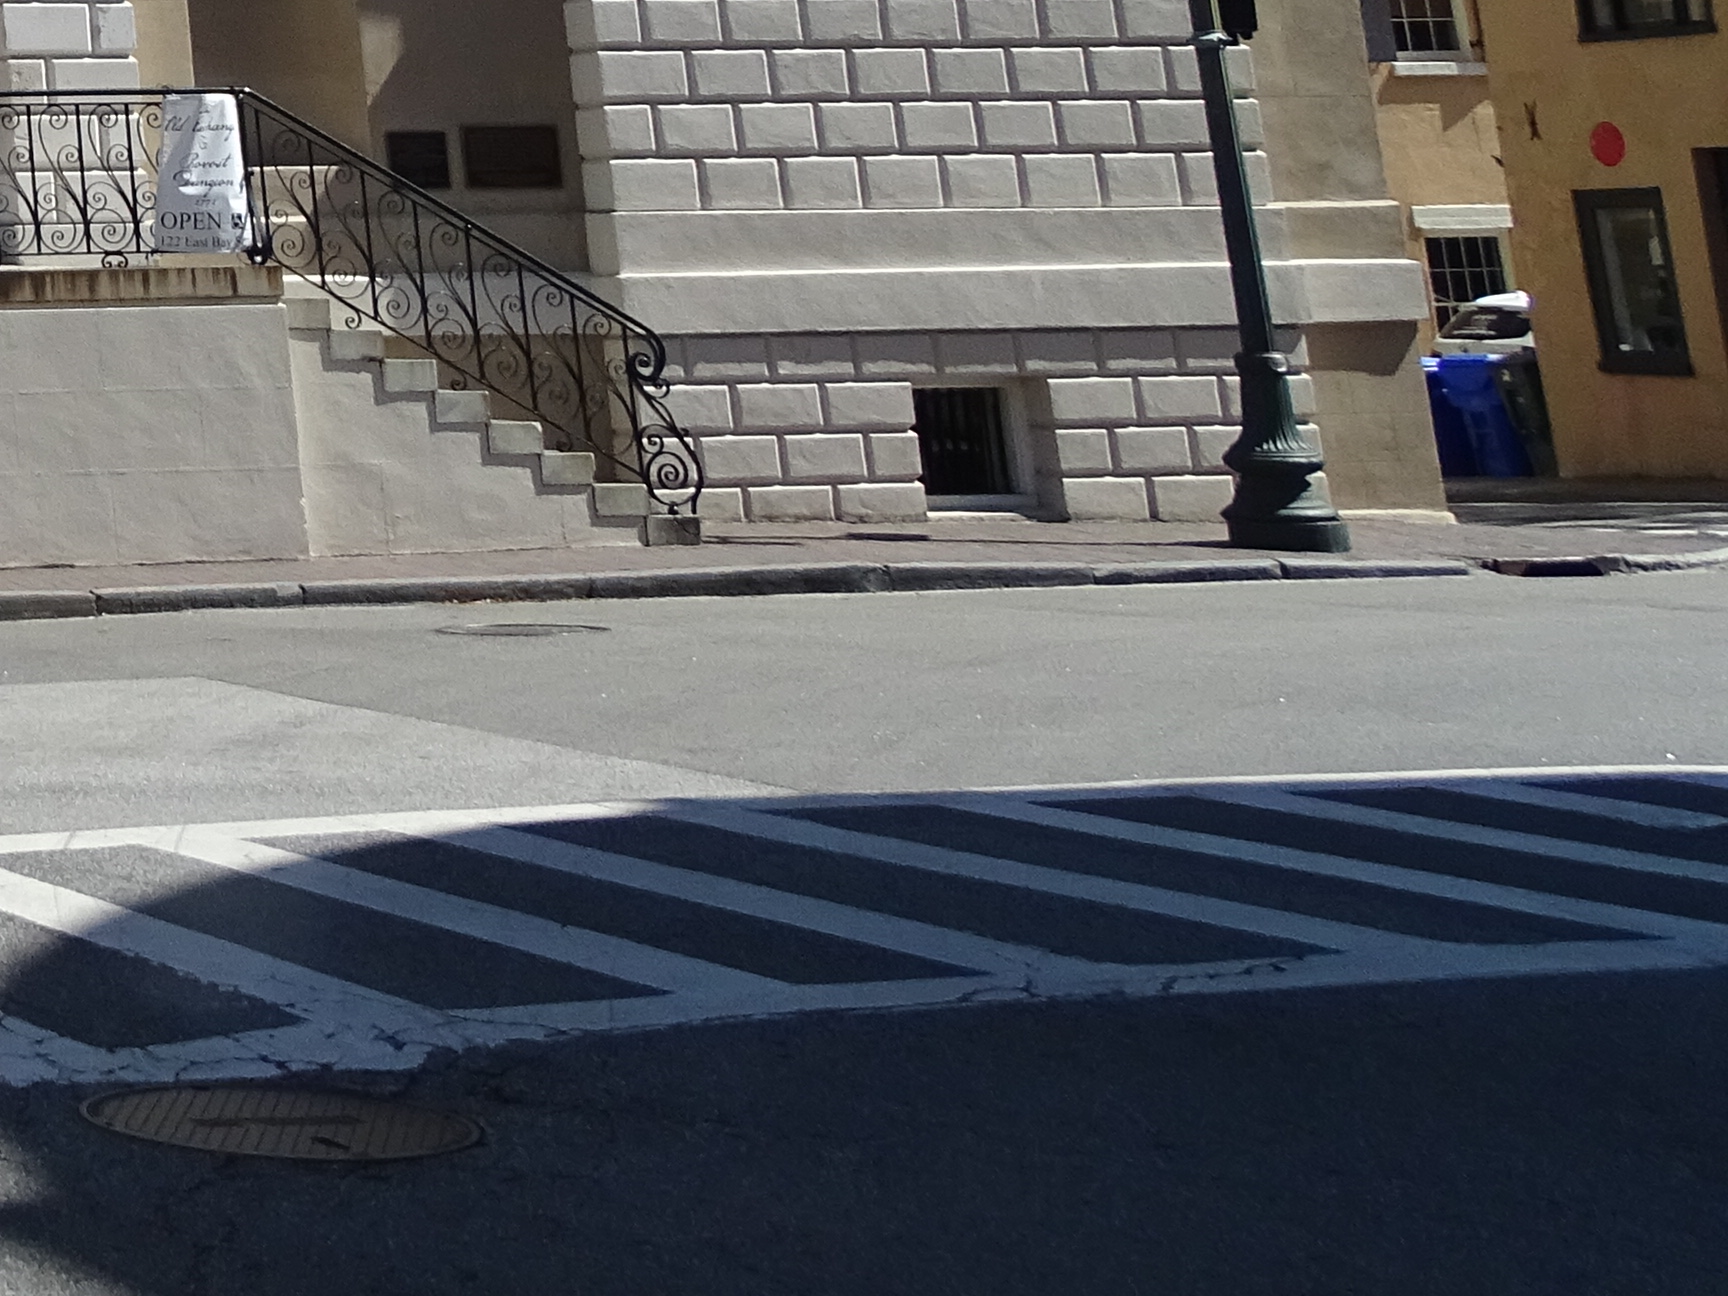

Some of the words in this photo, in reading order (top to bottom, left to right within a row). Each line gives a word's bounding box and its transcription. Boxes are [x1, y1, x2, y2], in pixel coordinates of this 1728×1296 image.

[160, 211, 222, 231] OPEN
[161, 236, 181, 247] 122
[185, 237, 208, 248] East
